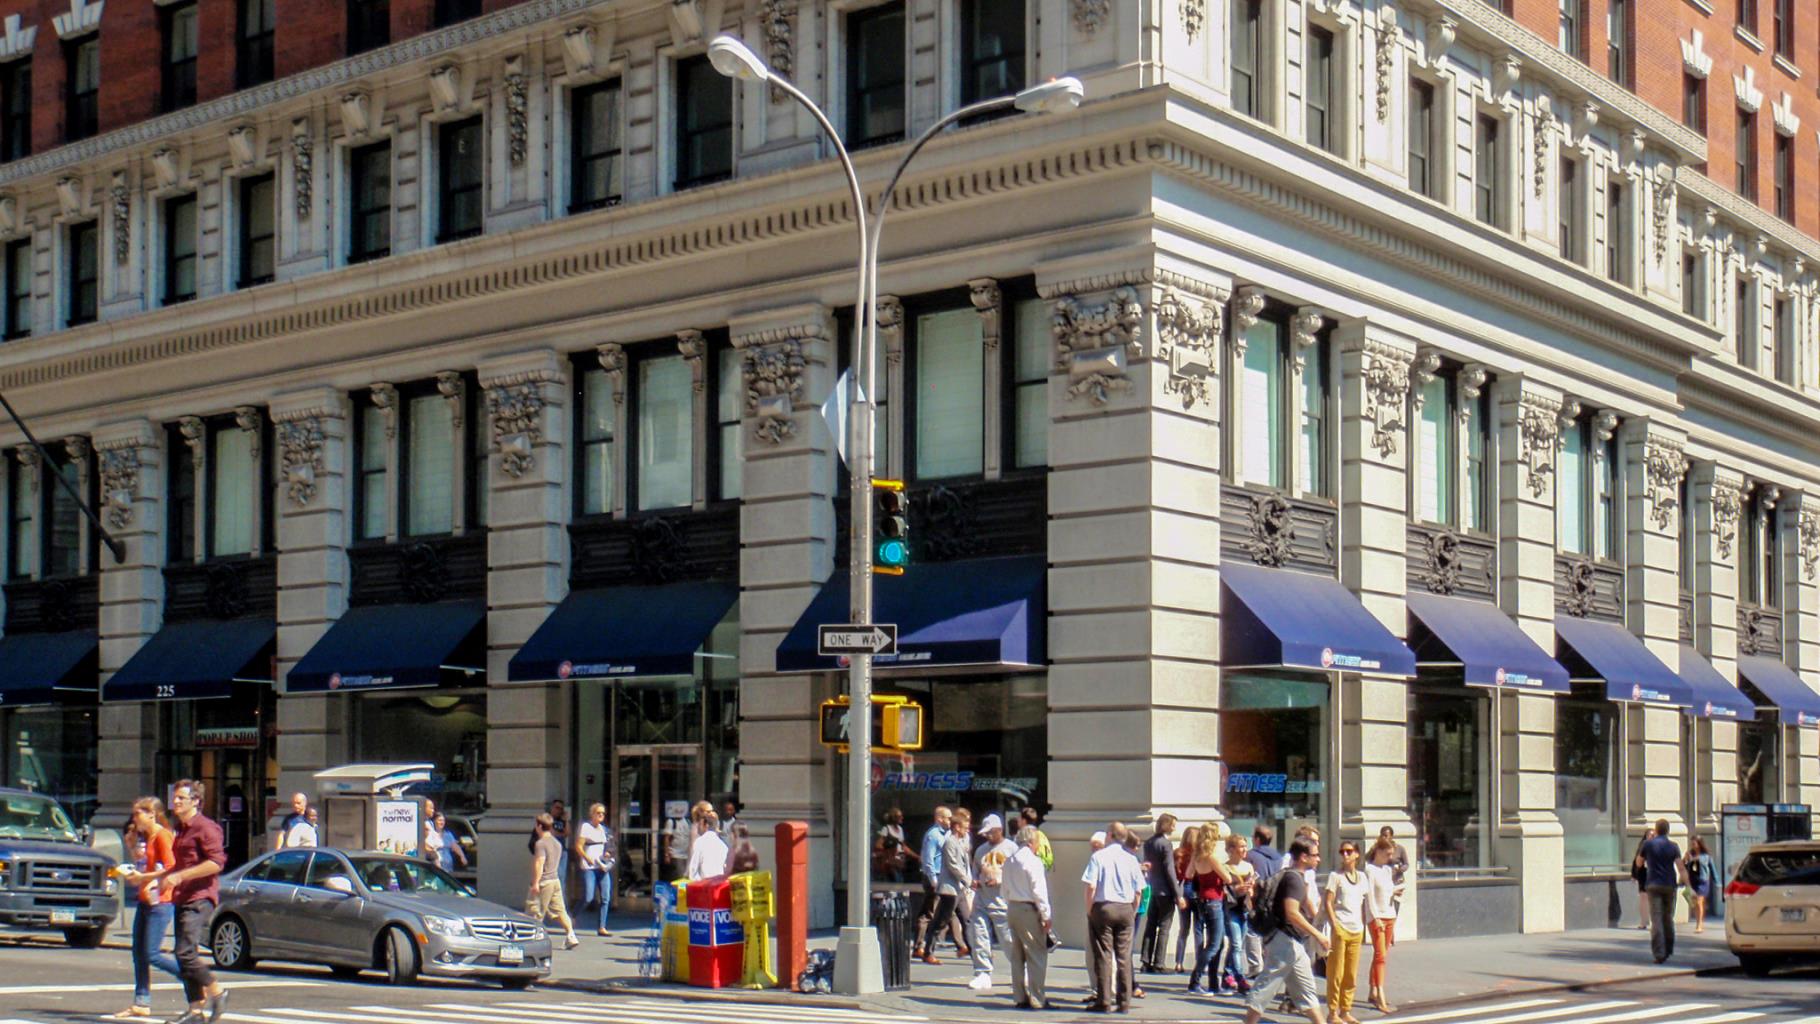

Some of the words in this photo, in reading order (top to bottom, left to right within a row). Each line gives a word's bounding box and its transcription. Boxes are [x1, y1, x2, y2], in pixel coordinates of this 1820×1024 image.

[830, 634, 852, 646] ONE
[861, 634, 884, 646] WAY
[156, 685, 175, 697] 225
[883, 771, 975, 791] FITNESS
[1226, 773, 1288, 793] FITNESS
[382, 814, 414, 823] normal
[689, 910, 711, 923] VOICE
